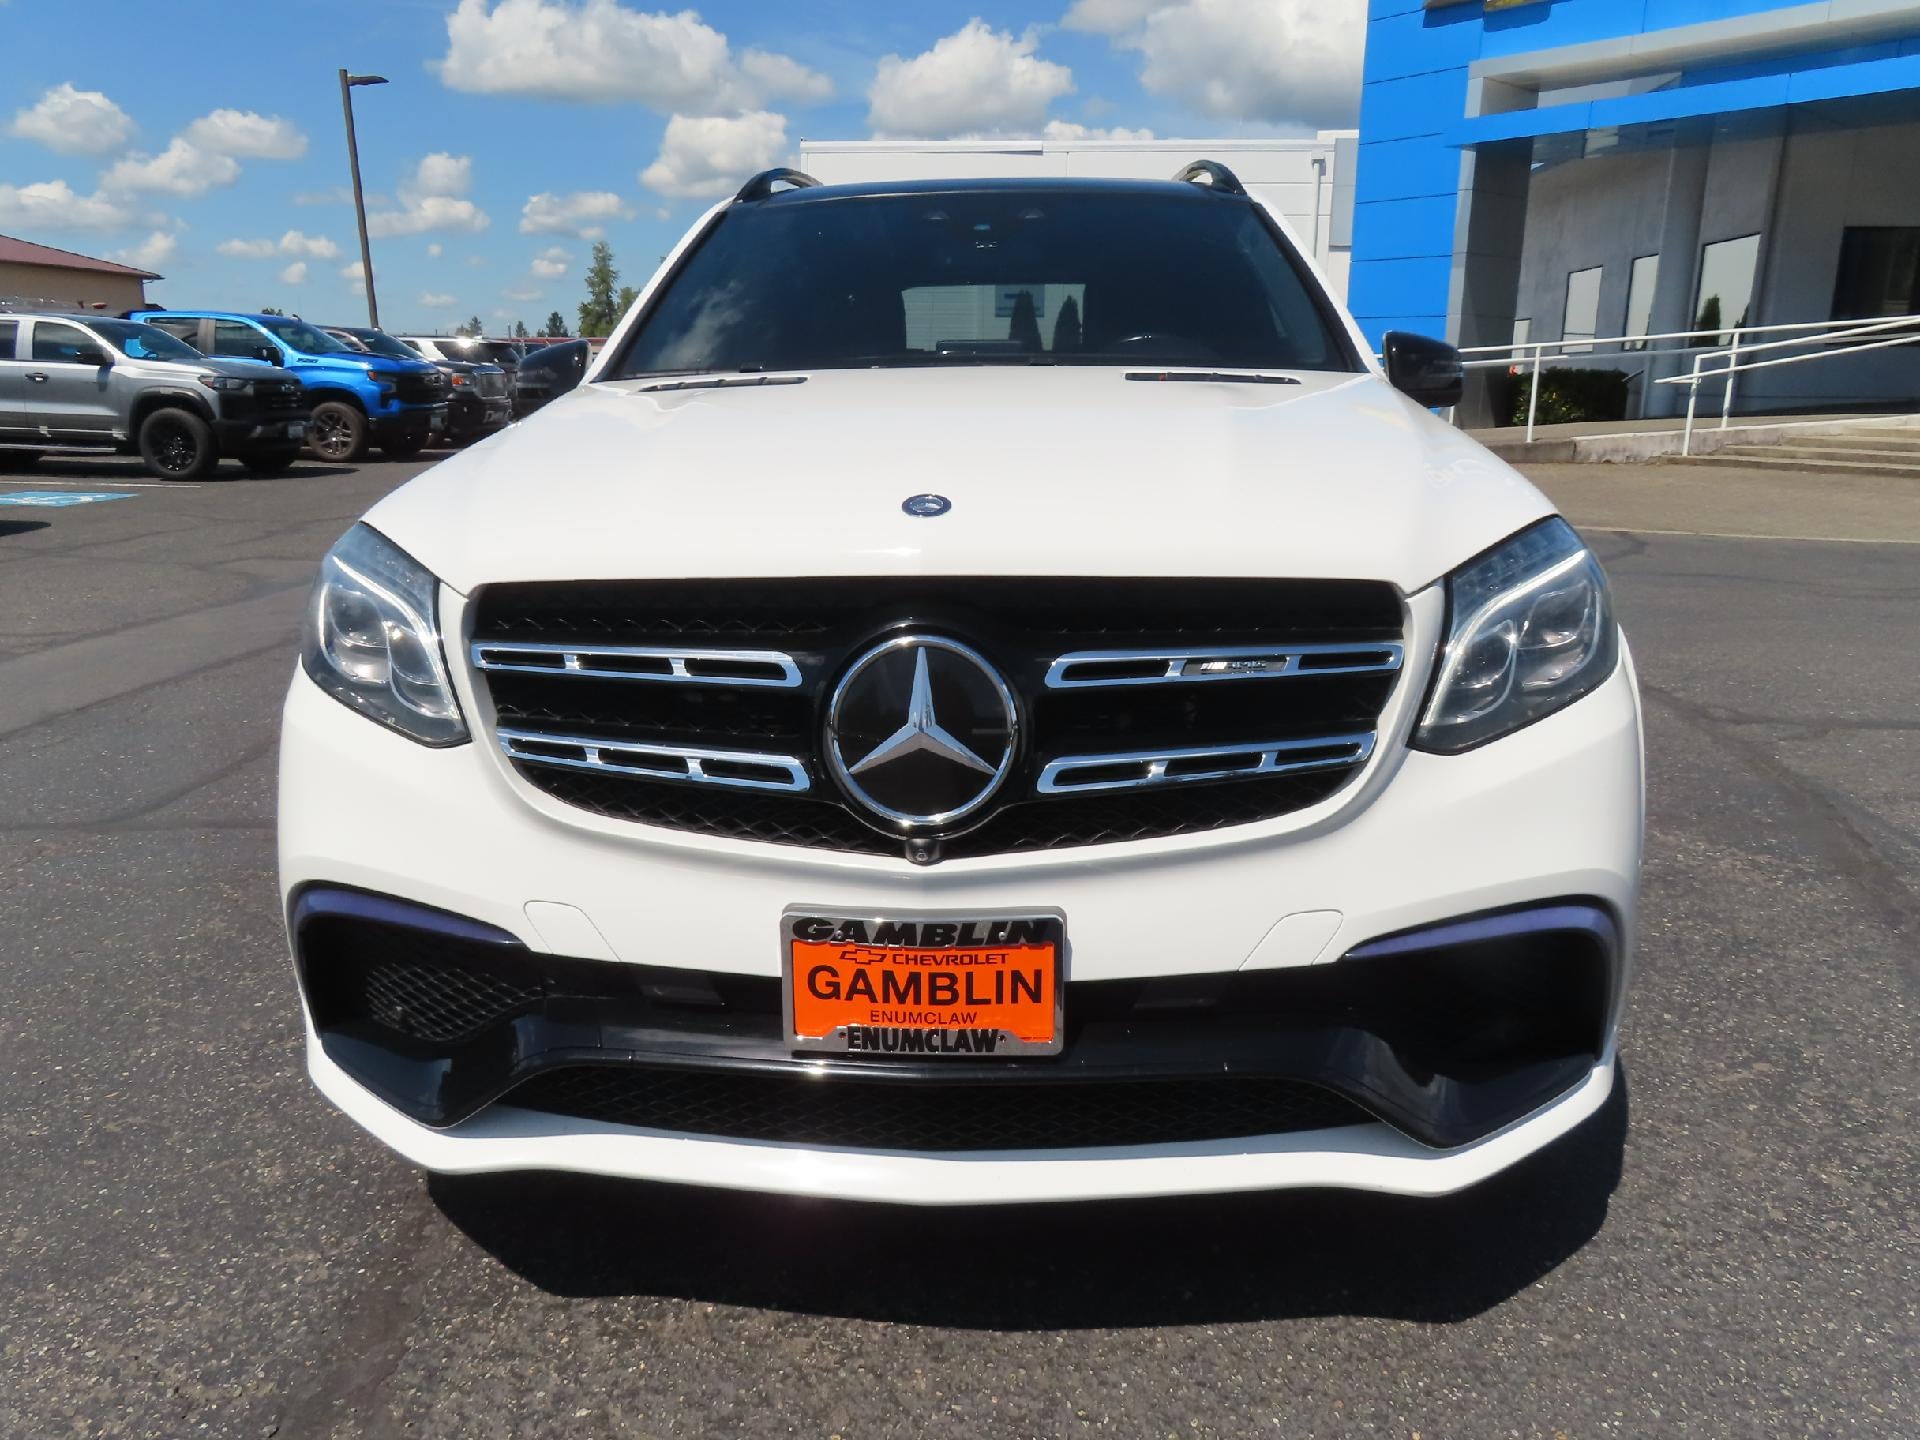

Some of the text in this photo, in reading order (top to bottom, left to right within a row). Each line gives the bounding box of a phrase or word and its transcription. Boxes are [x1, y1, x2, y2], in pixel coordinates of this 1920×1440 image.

[793, 917, 1050, 947] GAMBLIN
[892, 953, 1009, 966] CHEVROLET
[807, 965, 1042, 1005] GAMBLIN
[870, 1010, 977, 1024] ENUMCLAW
[847, 1026, 999, 1052] ENUMCLAW
